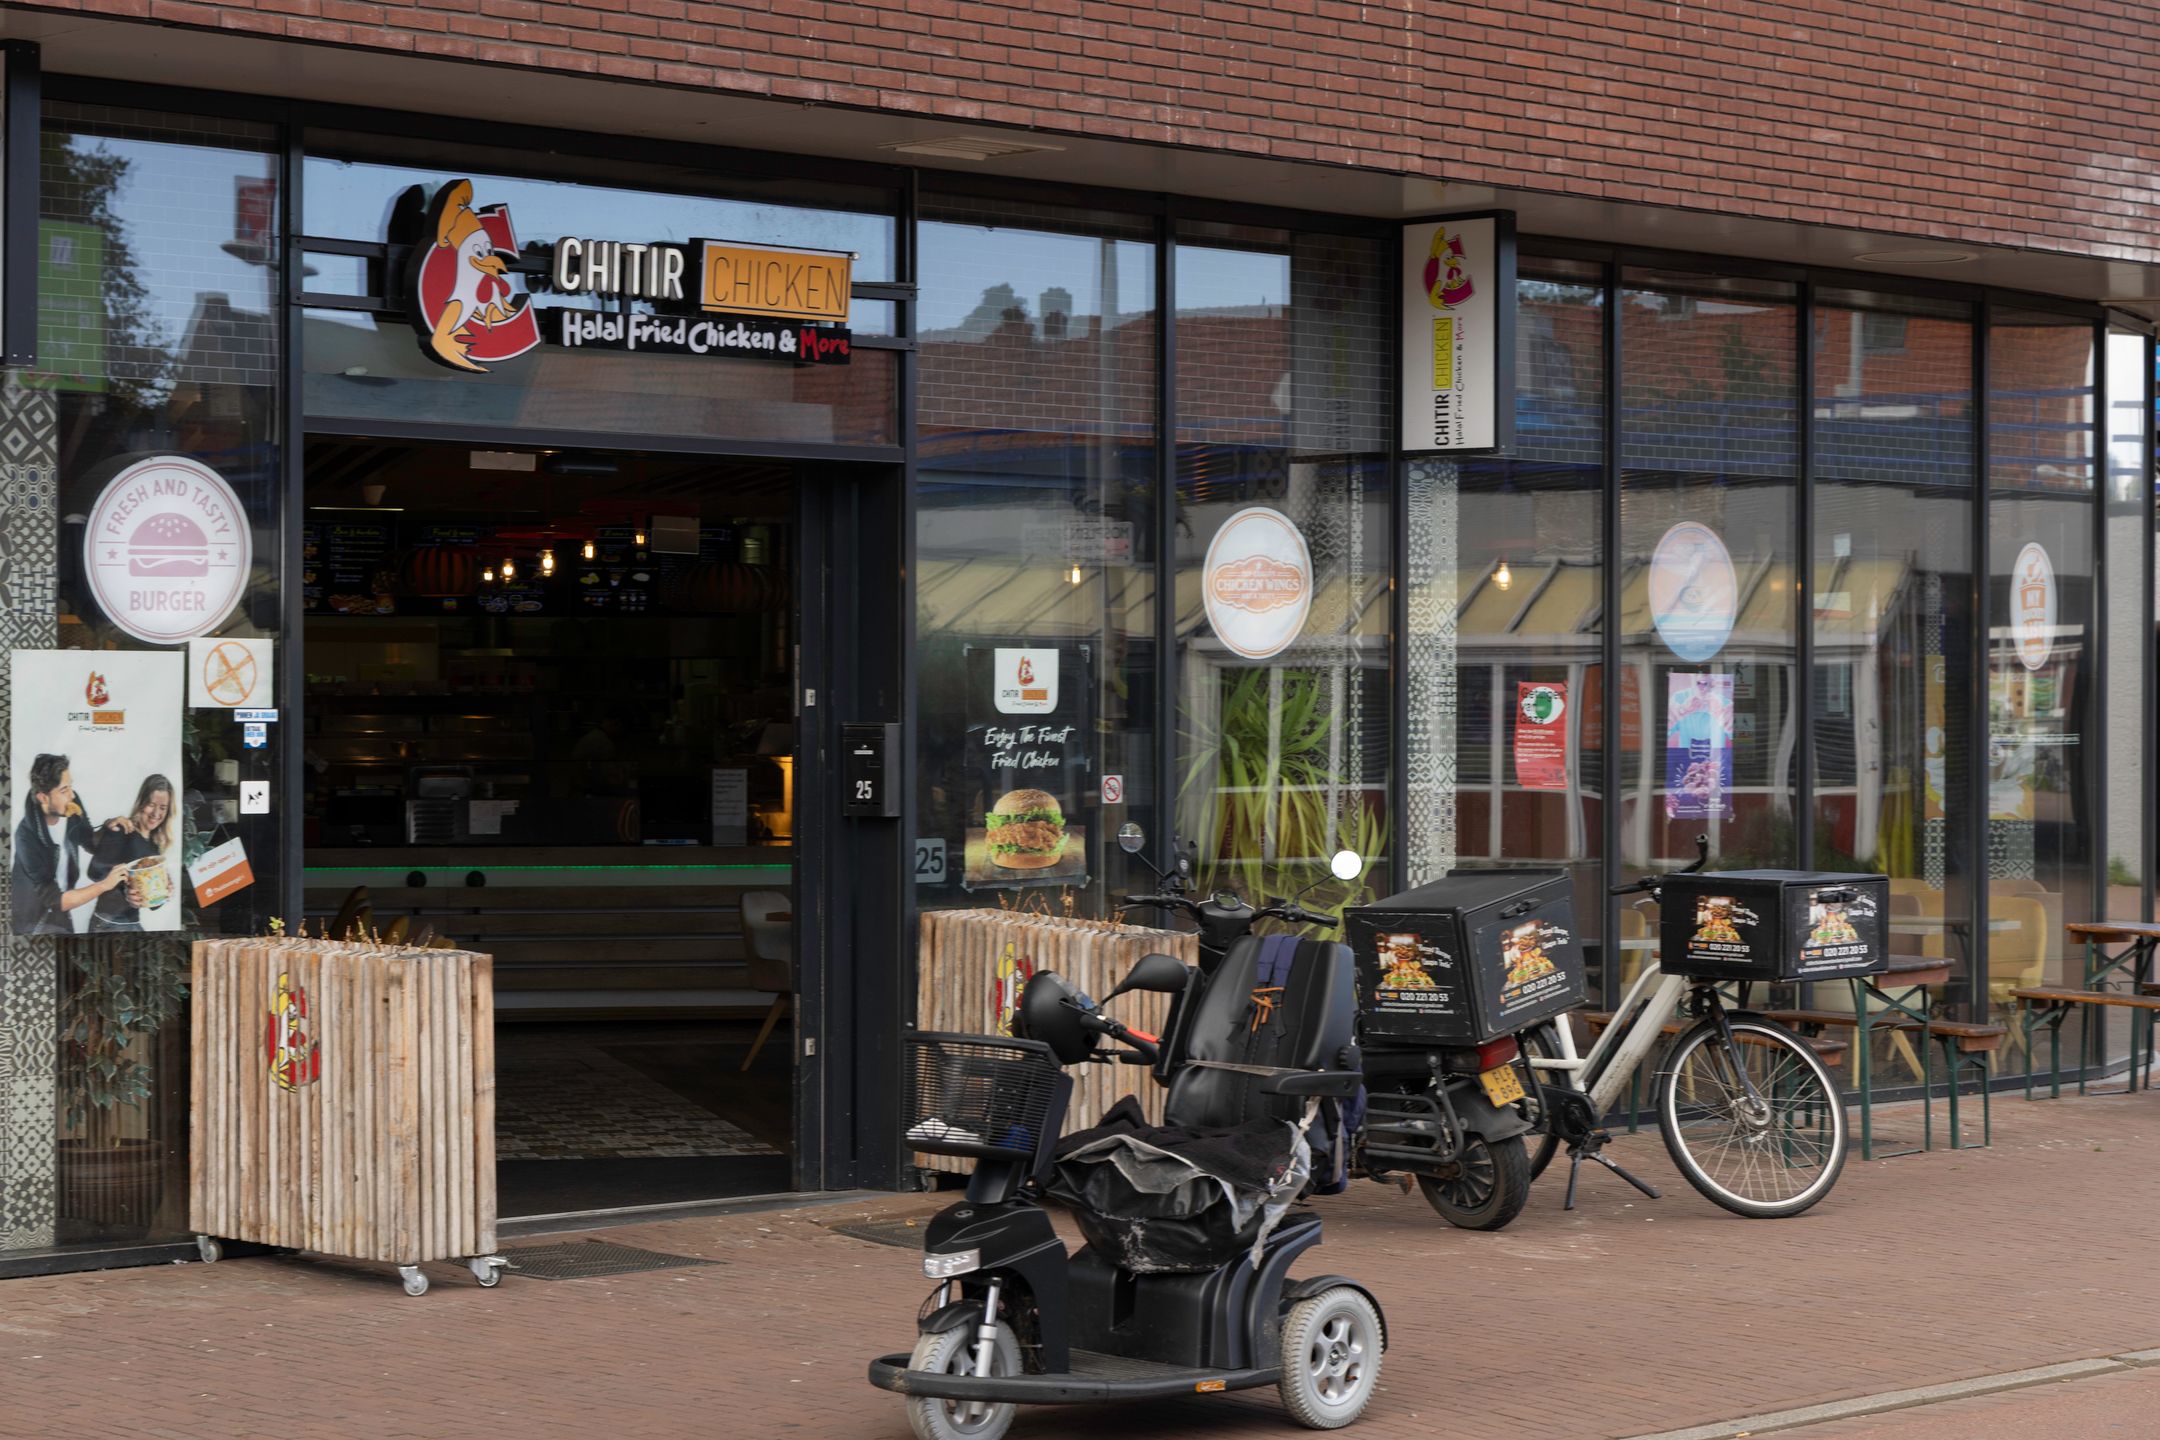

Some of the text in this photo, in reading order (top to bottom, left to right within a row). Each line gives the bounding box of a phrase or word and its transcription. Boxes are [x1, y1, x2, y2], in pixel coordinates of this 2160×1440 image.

[556, 236, 846, 312] CHITIR CHICKEN
[562, 311, 850, 361] Halal Fried Chicken & More
[1455, 316, 1464, 341] More
[1434, 320, 1450, 446] CHITIR CHICKEN
[1455, 354, 1465, 392] Chicken
[1455, 393, 1465, 420] Fried
[1455, 420, 1465, 446] Halal
[106, 479, 231, 536] FRESH AND TASTY
[129, 590, 206, 612] BURGER
[984, 725, 1076, 750] Enjoy The Finest
[991, 750, 1060, 773] Fried Chicken
[856, 780, 873, 800] 25
[915, 847, 944, 875] 25
